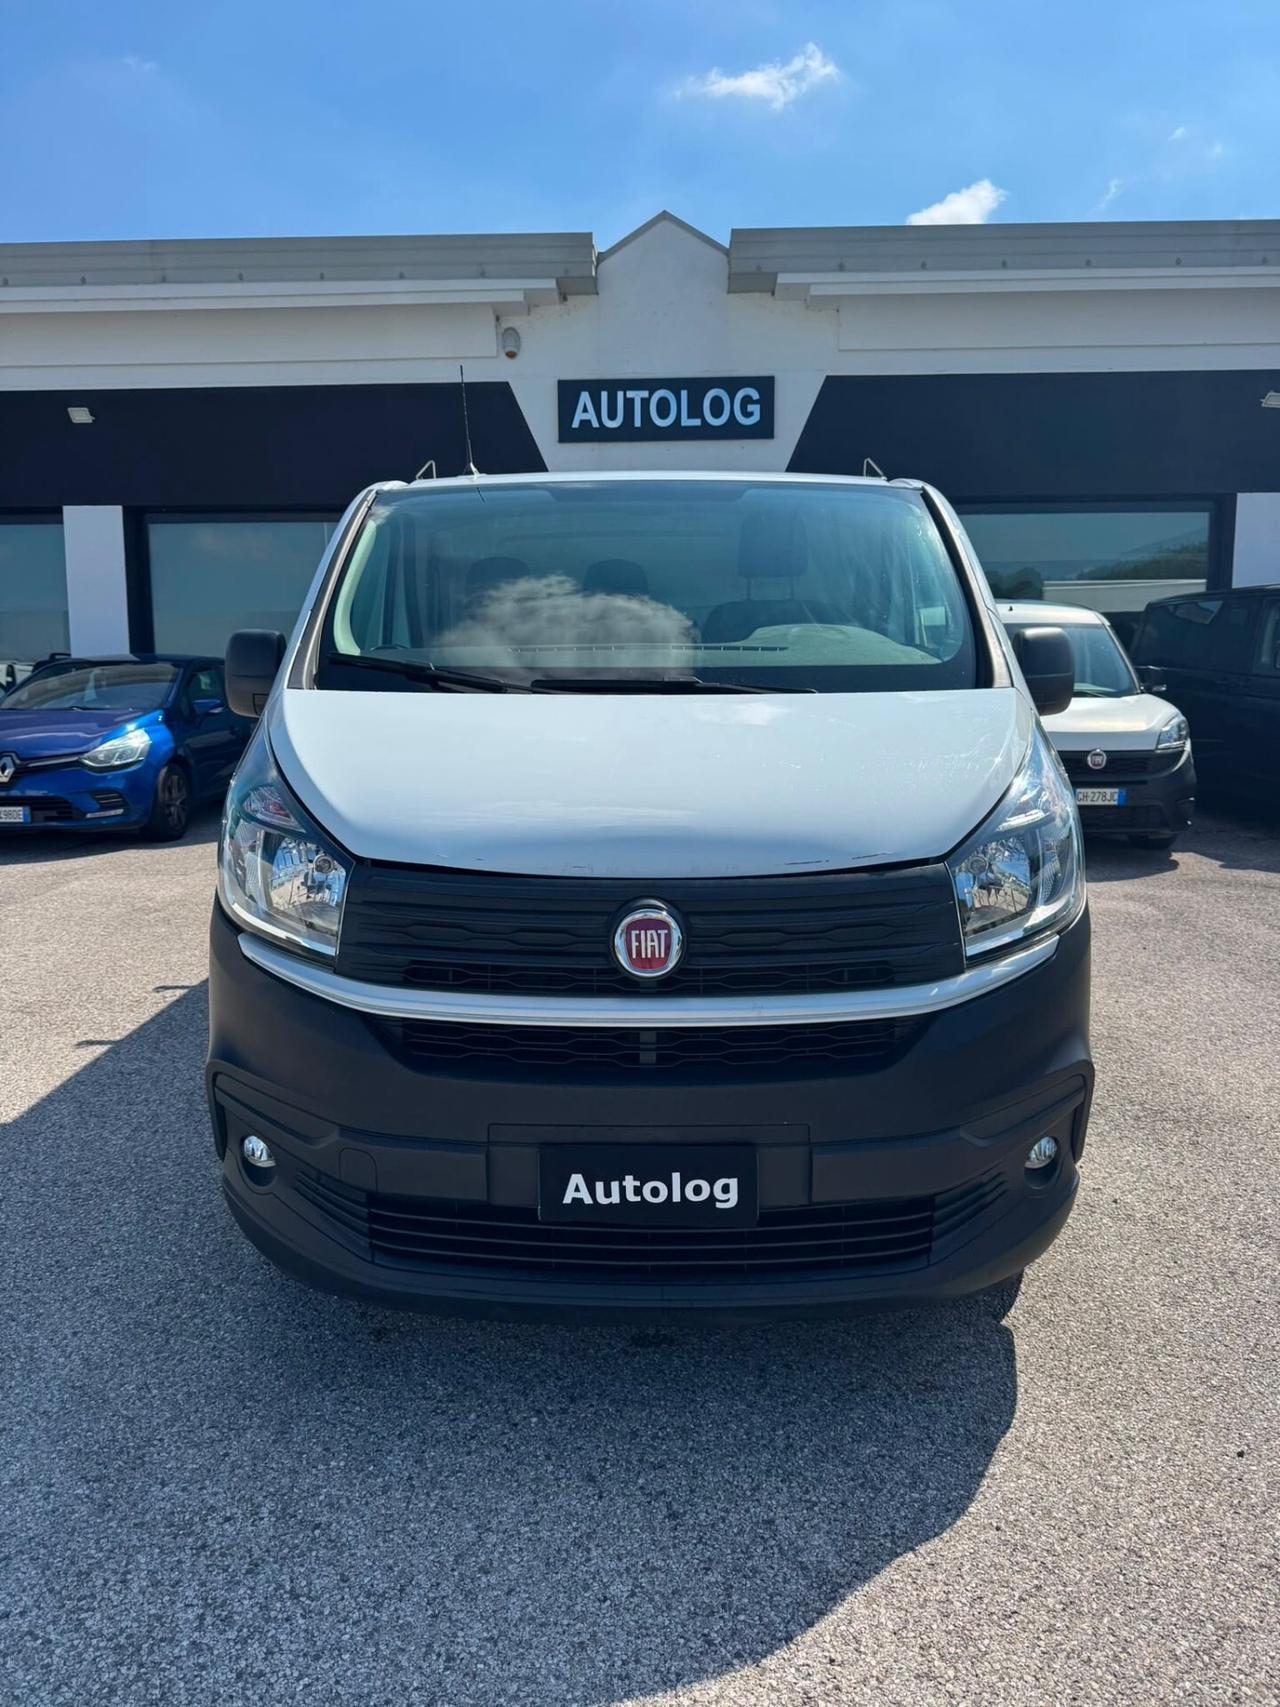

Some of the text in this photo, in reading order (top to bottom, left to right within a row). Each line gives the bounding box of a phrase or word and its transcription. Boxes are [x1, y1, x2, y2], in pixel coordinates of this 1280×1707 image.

[571, 387, 761, 429] AUTOLOG
[631, 929, 668, 959] FIAT
[562, 1171, 739, 1209] Autolog
